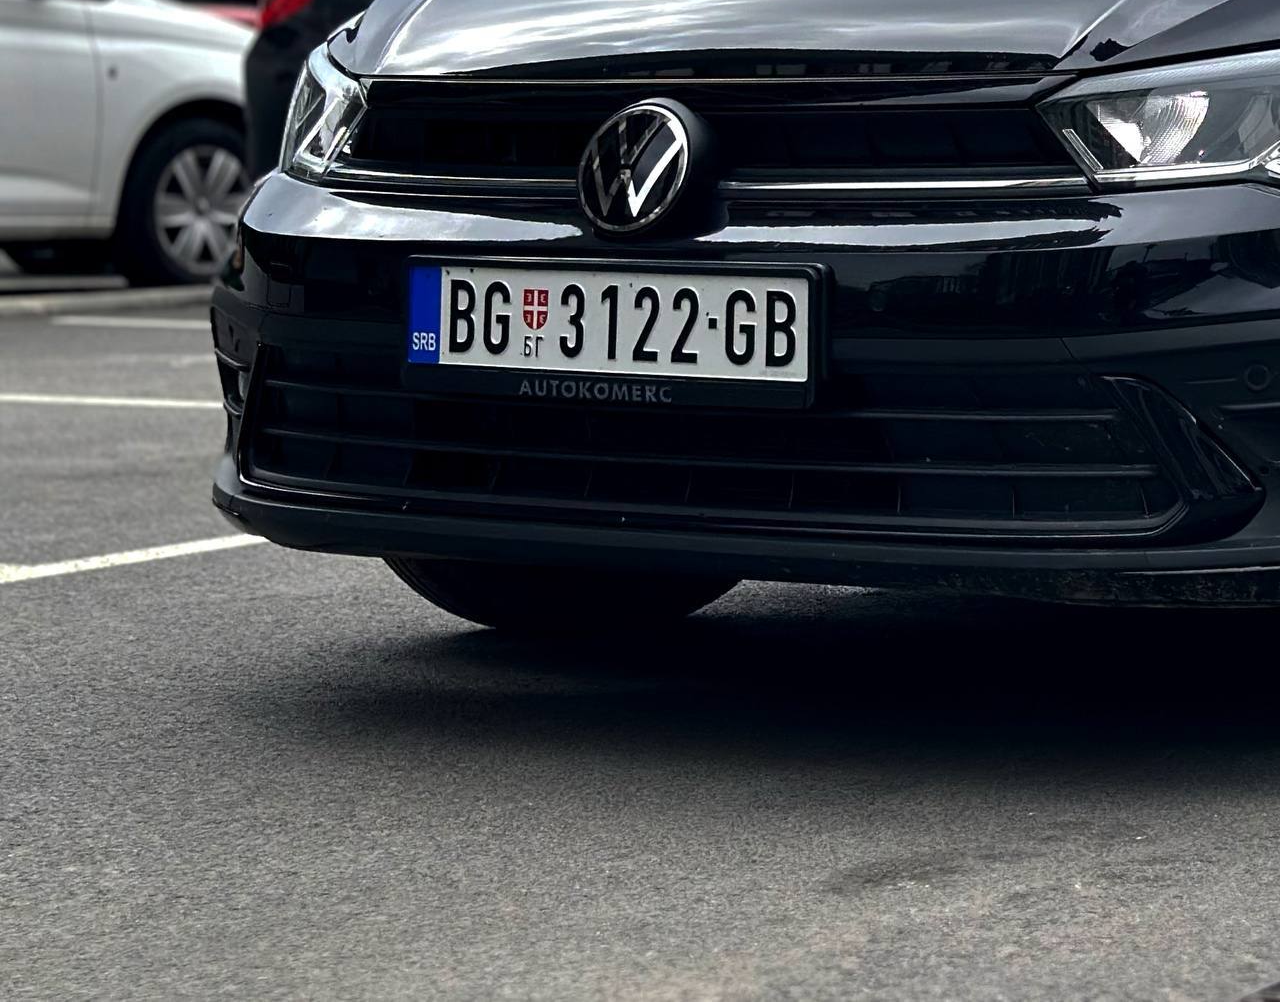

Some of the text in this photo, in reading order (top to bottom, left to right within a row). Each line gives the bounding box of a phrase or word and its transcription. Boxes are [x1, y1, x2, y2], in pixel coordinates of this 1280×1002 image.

[449, 279, 511, 355] BG
[412, 332, 436, 351] SRB
[519, 379, 673, 403] AUTOKOMERC
